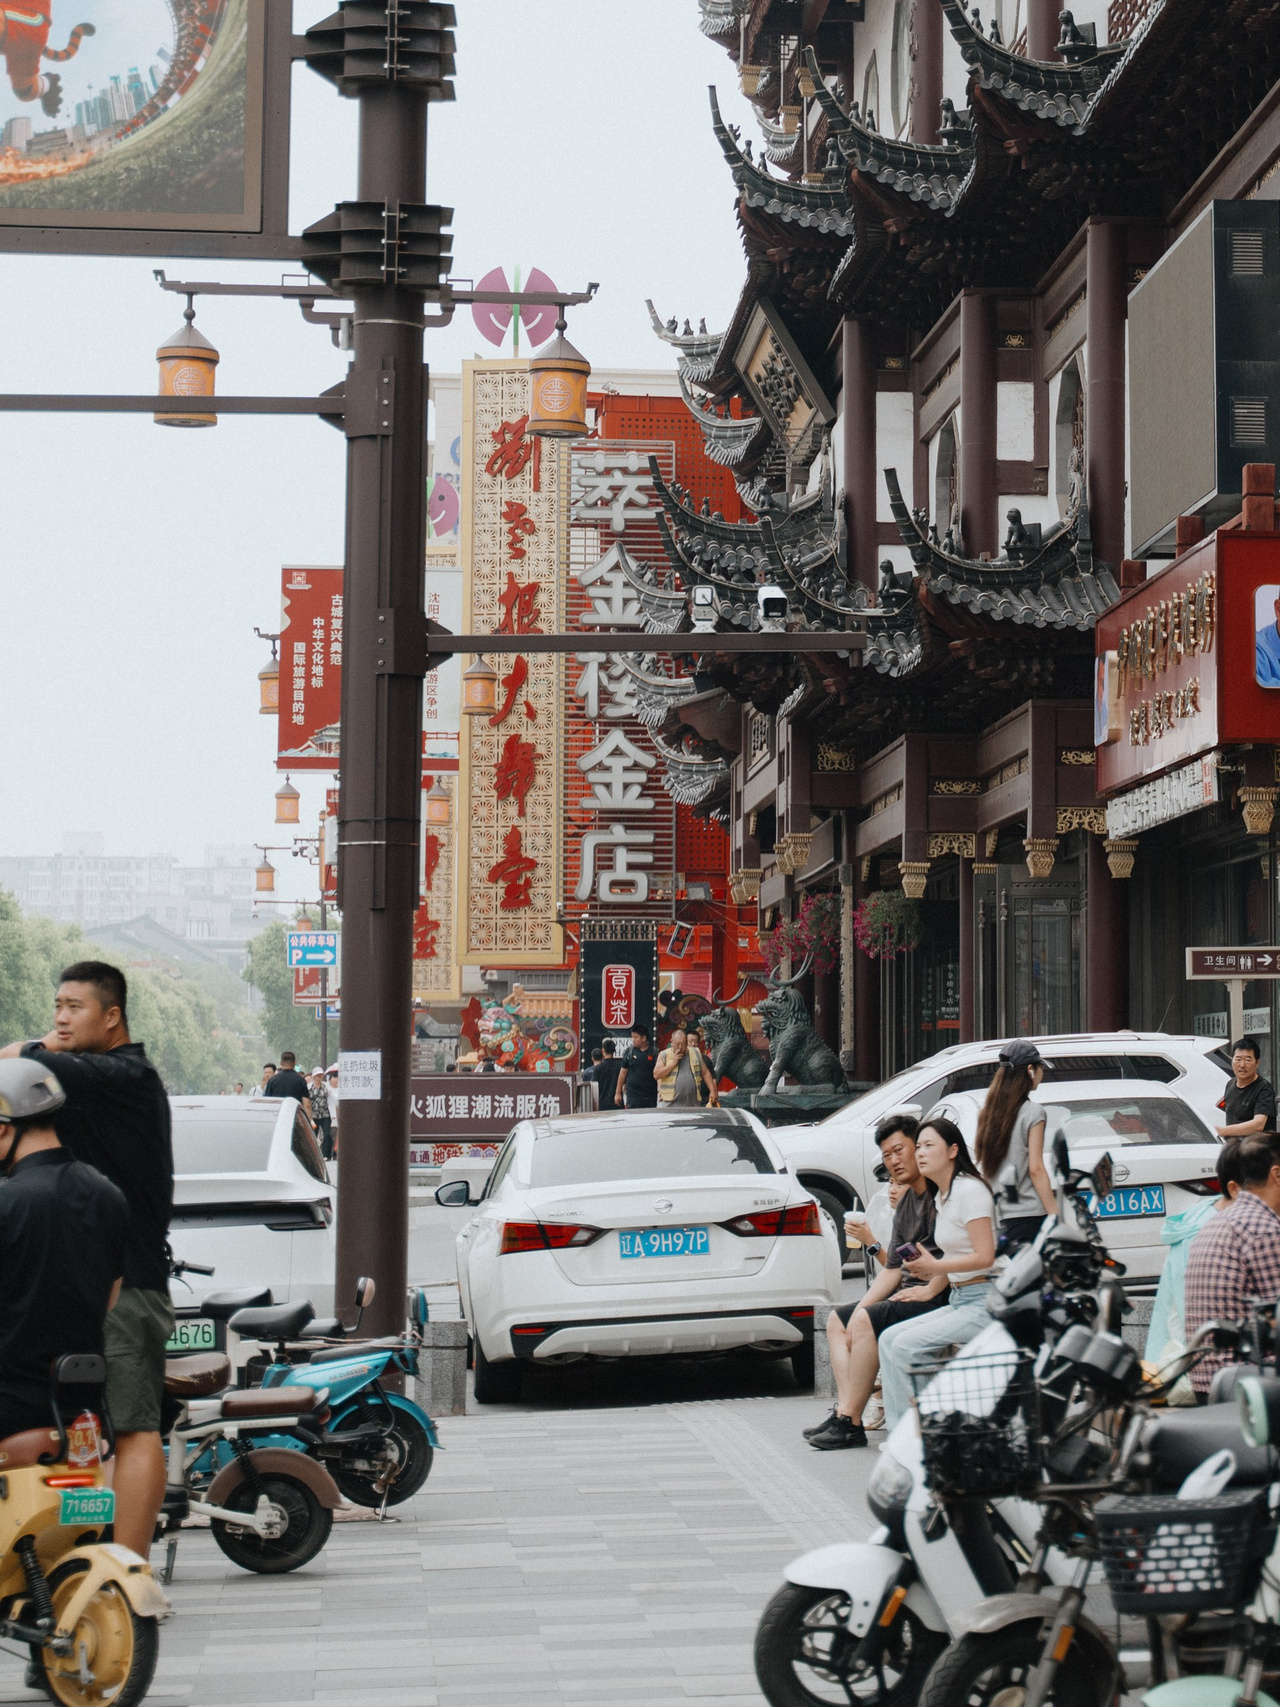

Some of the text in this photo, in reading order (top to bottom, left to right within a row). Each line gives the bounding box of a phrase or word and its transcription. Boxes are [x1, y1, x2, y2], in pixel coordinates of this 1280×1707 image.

[330, 594, 344, 665] 古城复兴典范
[311, 617, 325, 688] 中华文化地标
[292, 642, 306, 725] 国际旅游目的地
[290, 935, 335, 948] 公共停车场
[292, 949, 303, 965] P
[1204, 955, 1236, 966] 卫生间
[66, 1498, 111, 1514] 716657
